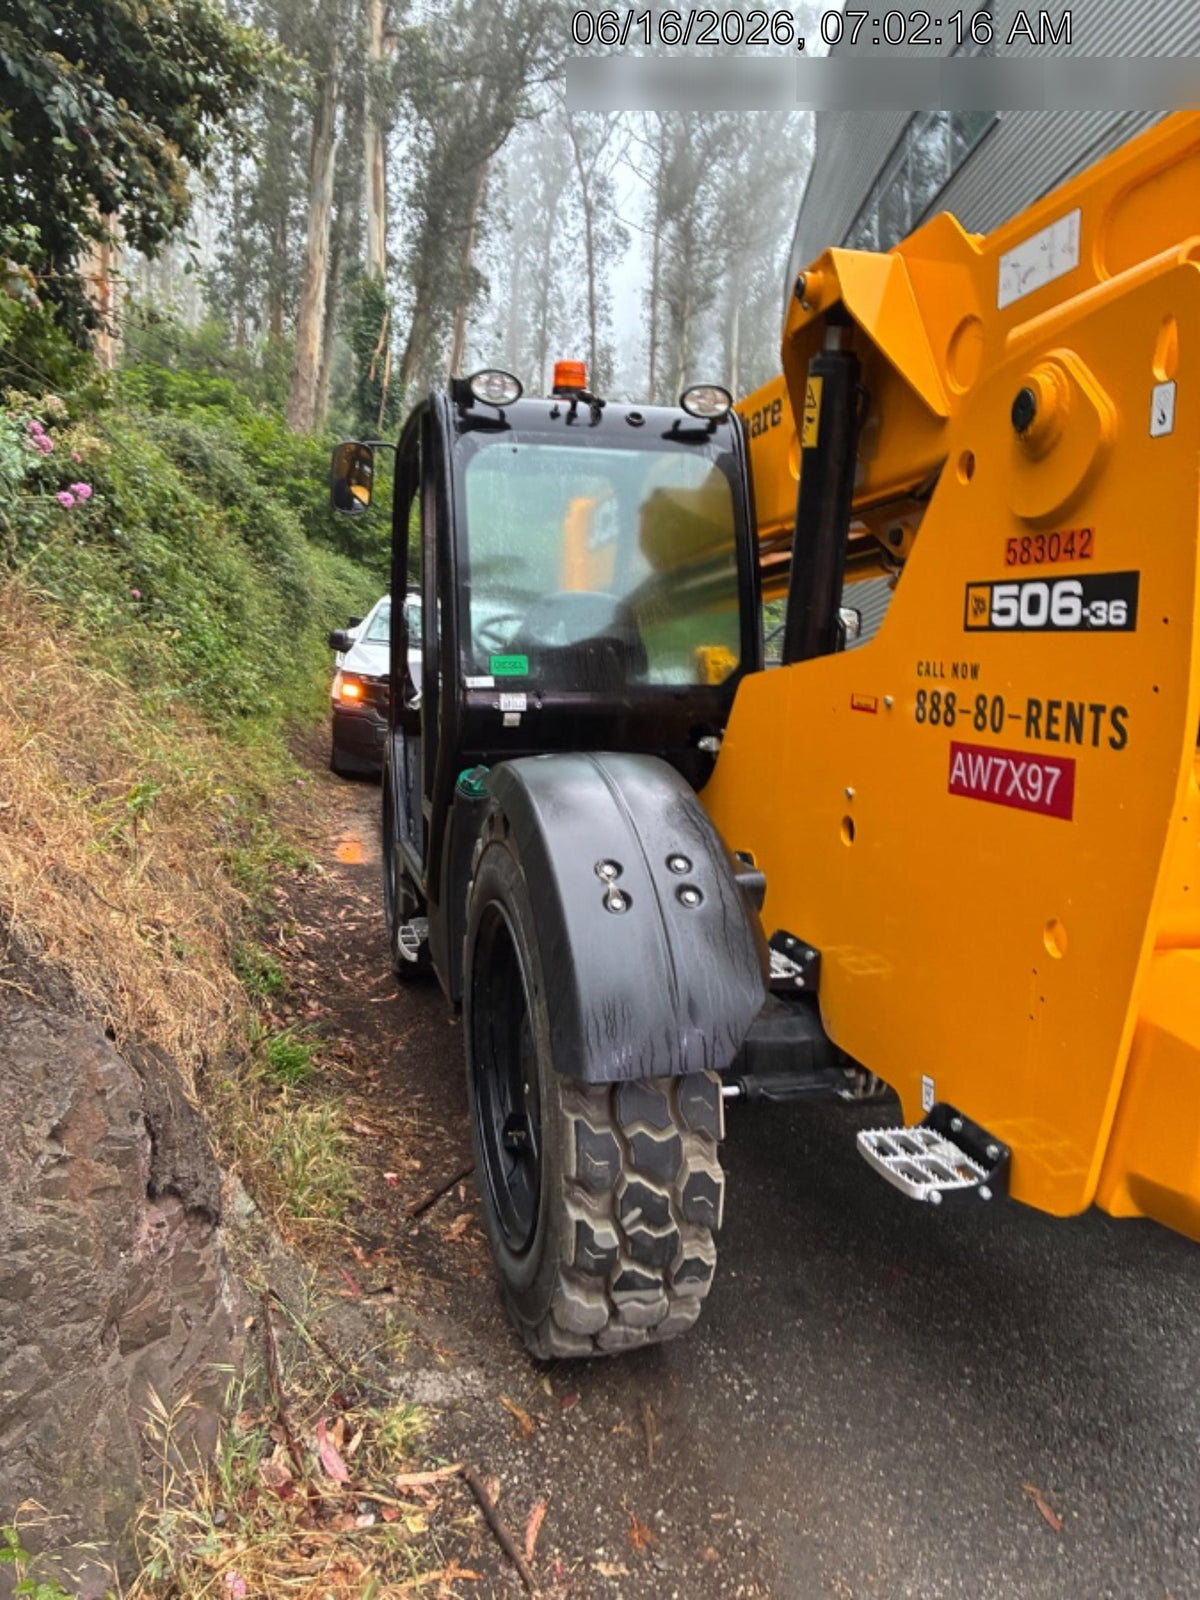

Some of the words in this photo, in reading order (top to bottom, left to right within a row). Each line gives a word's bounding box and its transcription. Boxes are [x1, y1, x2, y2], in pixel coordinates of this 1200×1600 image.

[1006, 528, 1093, 566] 583042
[917, 661, 945, 678] CALL
[951, 662, 980, 680] NOW
[915, 689, 1129, 750] 888-80-RENTS
[950, 751, 1061, 805] AW7X97
